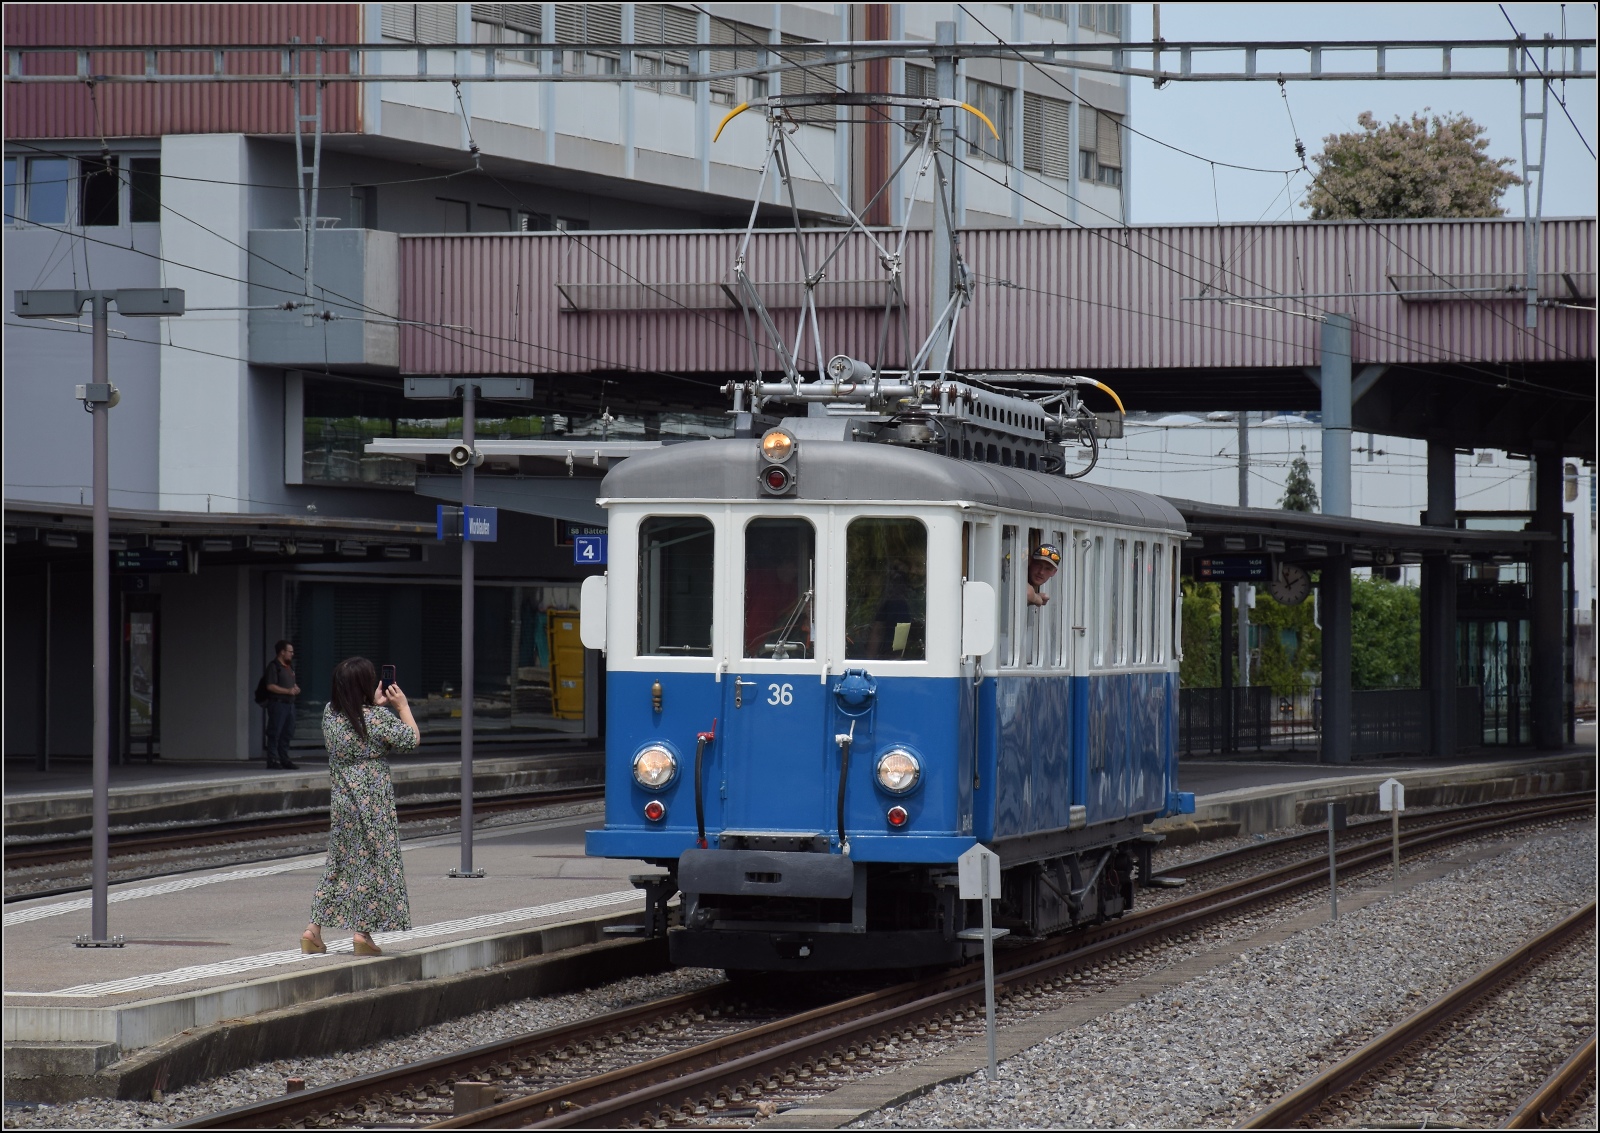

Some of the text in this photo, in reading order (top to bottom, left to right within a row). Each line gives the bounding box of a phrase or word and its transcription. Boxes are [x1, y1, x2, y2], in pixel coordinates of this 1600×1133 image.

[468, 517, 490, 535] Worblaufen
[582, 544, 595, 560] 4
[136, 578, 144, 589] 3
[767, 683, 794, 706] 36
